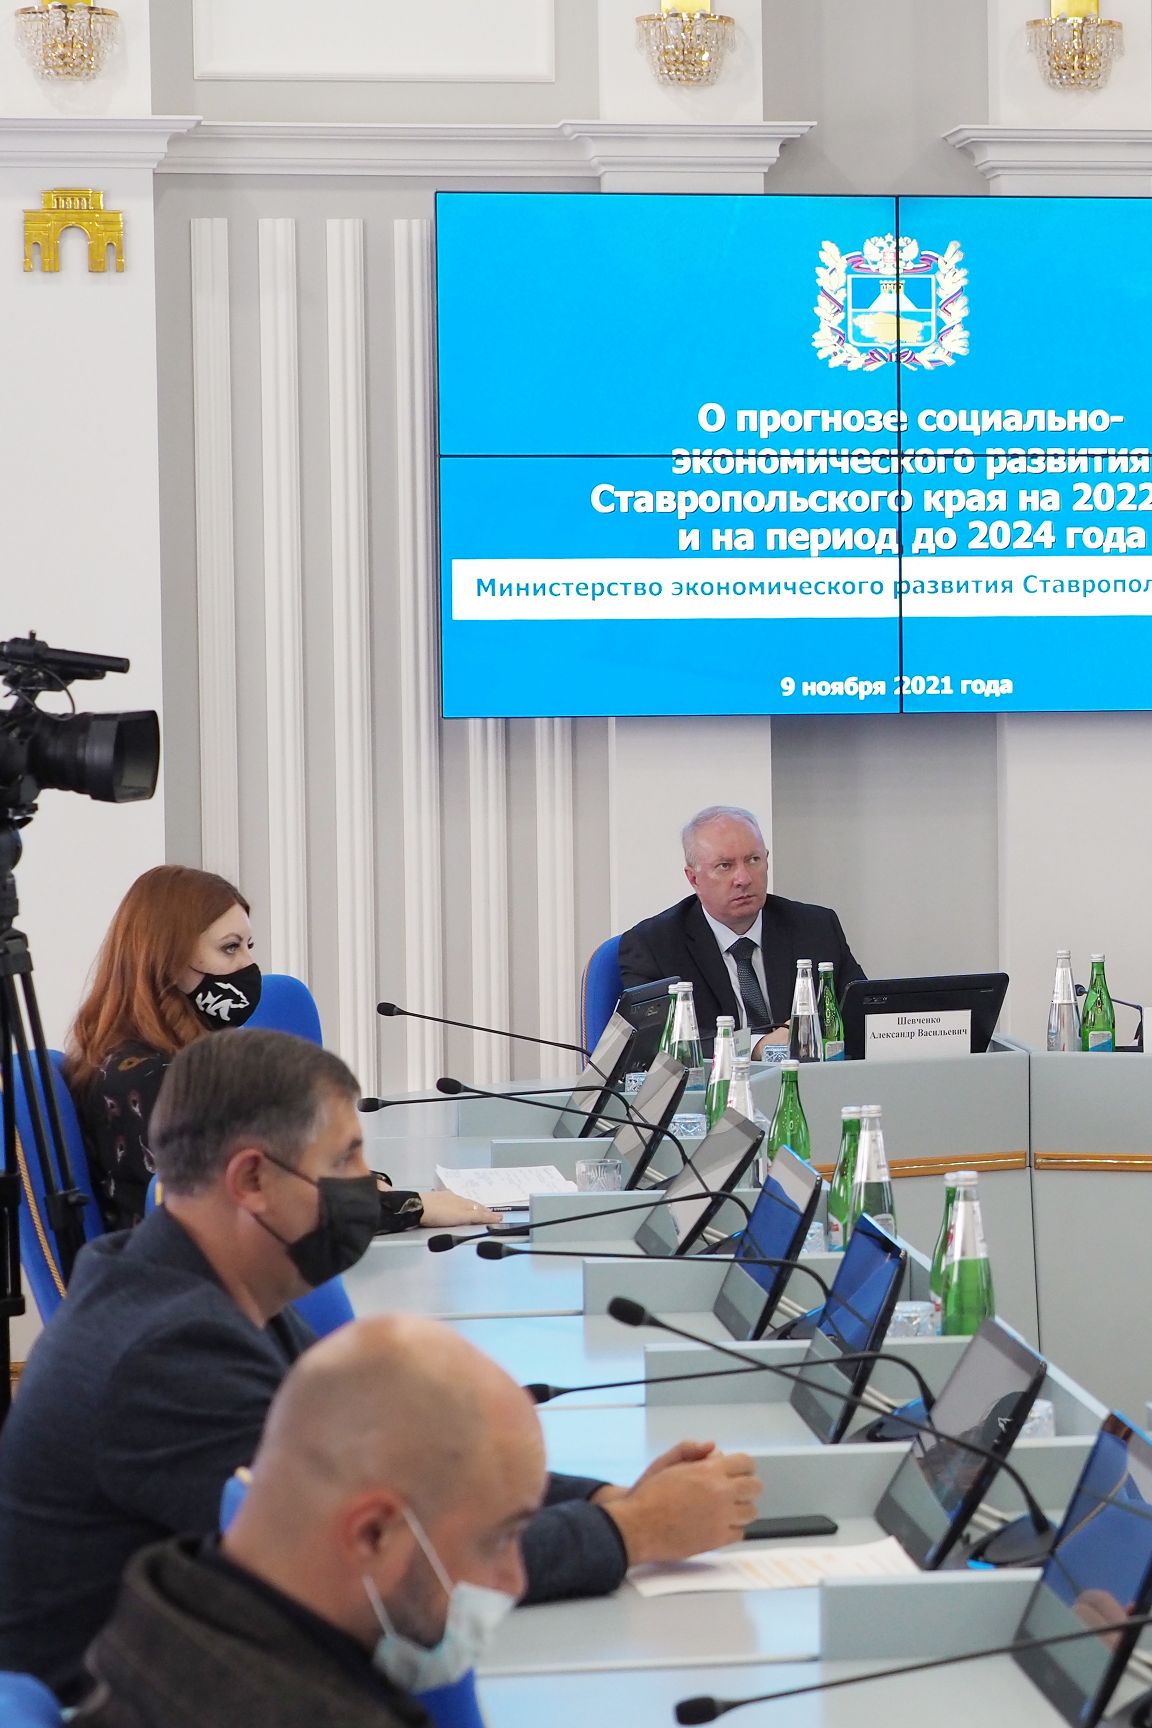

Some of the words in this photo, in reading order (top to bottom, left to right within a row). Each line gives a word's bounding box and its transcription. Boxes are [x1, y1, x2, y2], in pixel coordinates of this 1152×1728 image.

[698, 402, 726, 432] О
[736, 409, 908, 439] прогнозе
[917, 408, 1124, 436] социально-
[671, 447, 976, 475] экономического
[986, 447, 1150, 480] развития
[590, 483, 913, 520] Ставропольского
[923, 488, 1007, 518] края
[1018, 488, 1060, 512] на
[678, 528, 700, 551] и
[711, 528, 754, 551] на
[766, 528, 902, 557] период
[911, 526, 957, 554] до
[967, 520, 1056, 549] 2024
[1066, 526, 1146, 554] года
[476, 578, 662, 601] Министерство
[671, 579, 884, 597] экономического
[893, 577, 1014, 598] развития
[780, 676, 796, 696] 9
[802, 676, 886, 700] ноября
[894, 675, 954, 696] 2021
[960, 680, 1014, 697] года
[869, 1030, 916, 1040] Александр
[917, 1028, 968, 1038] Васильевич
[897, 1016, 941, 1025] Шевченко
